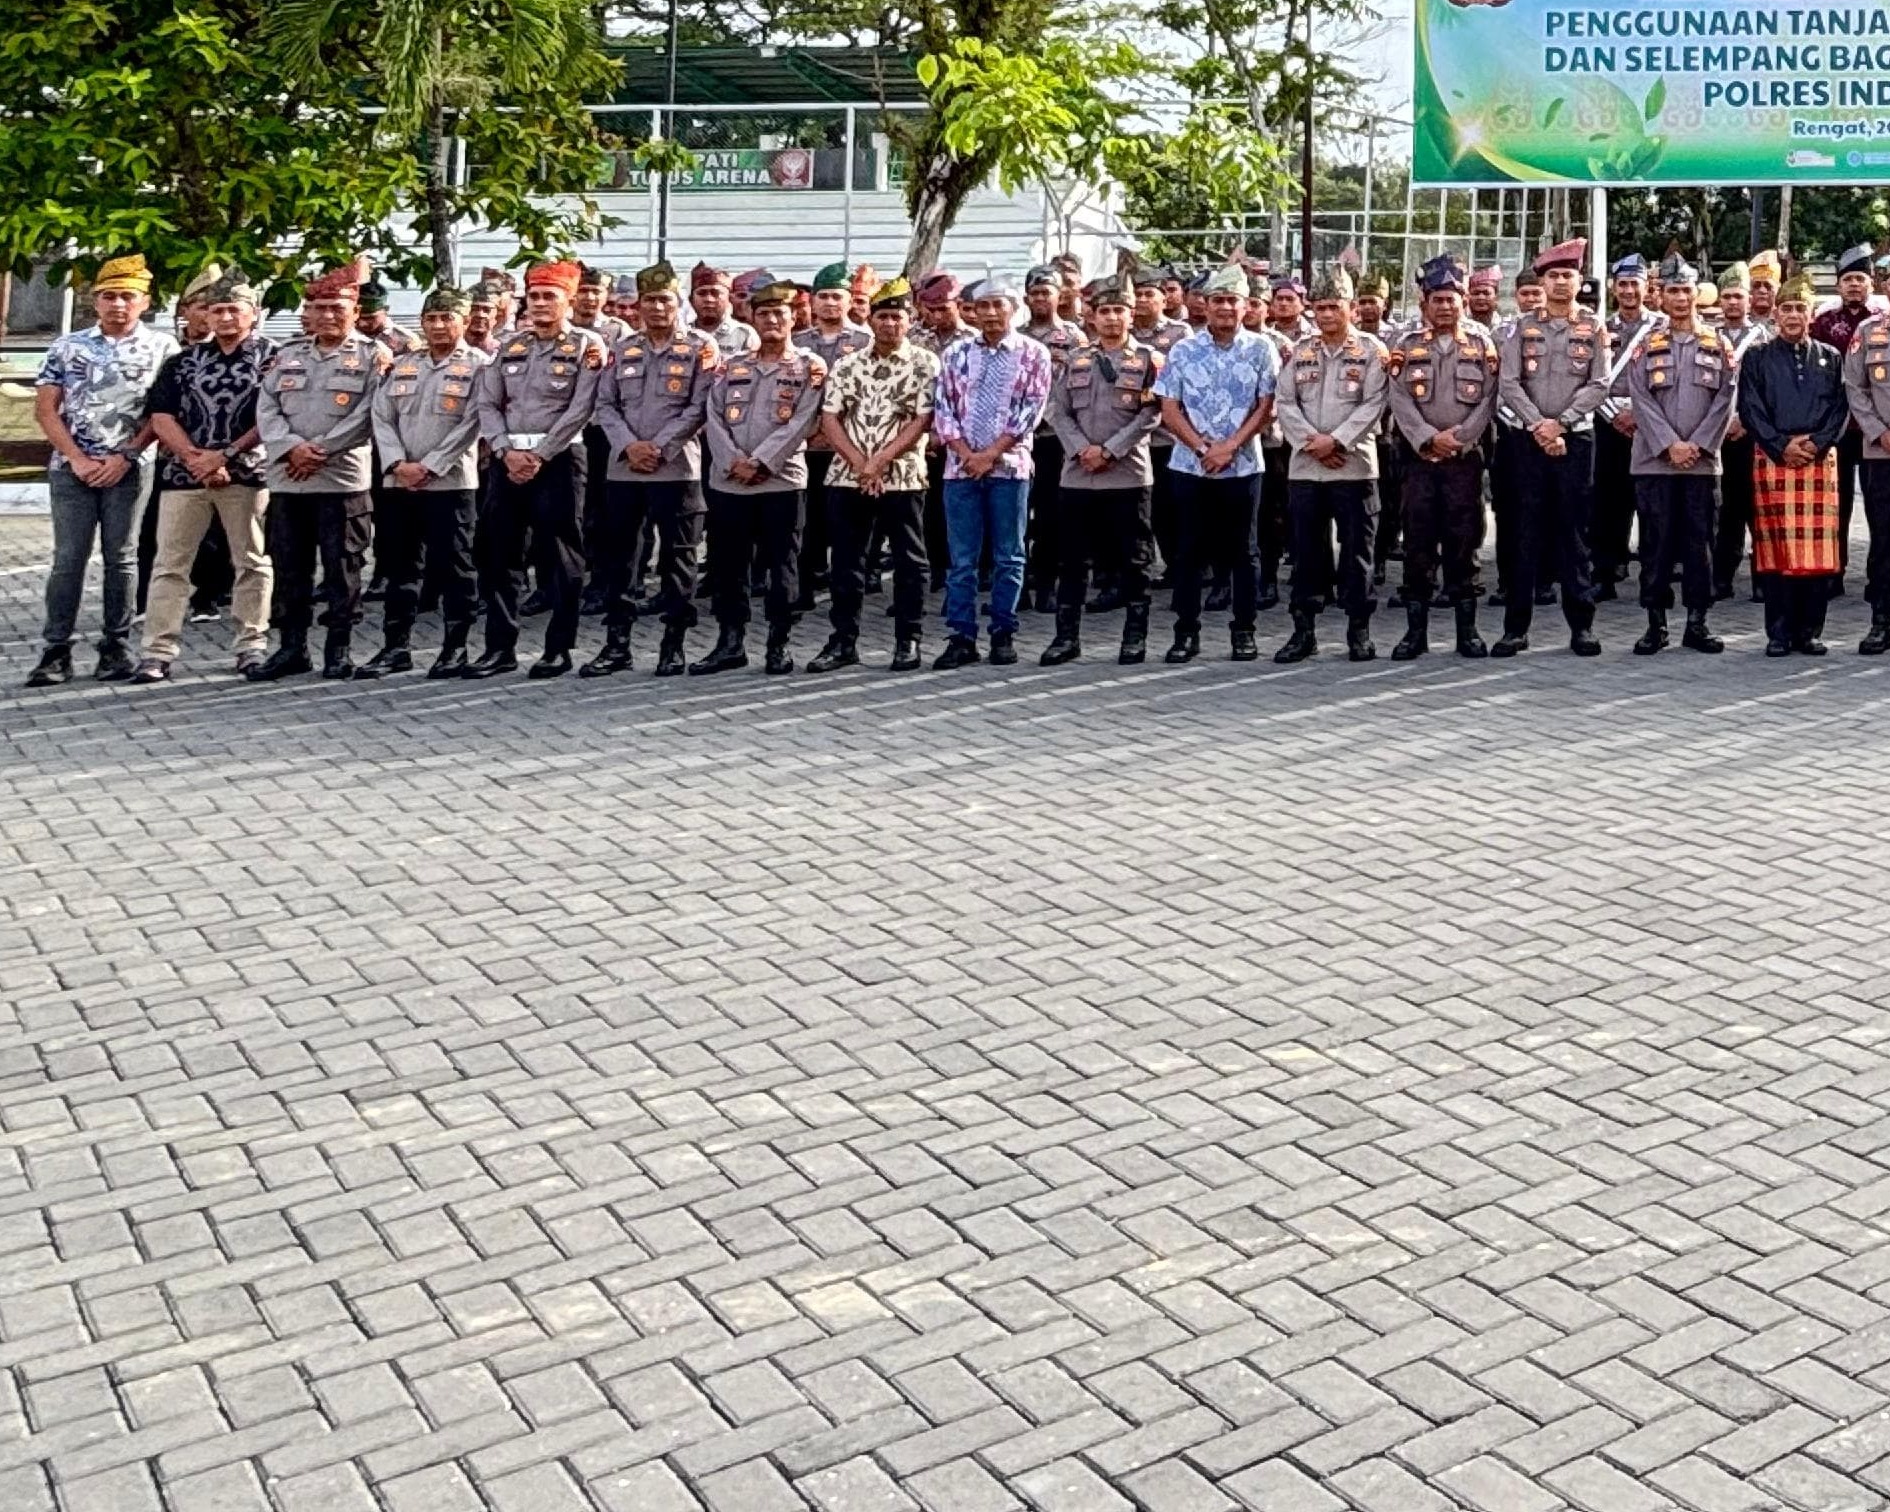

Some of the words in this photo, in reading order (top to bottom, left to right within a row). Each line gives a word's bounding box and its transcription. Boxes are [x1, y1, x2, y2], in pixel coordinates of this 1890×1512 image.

[1546, 10, 1778, 37] PENGGUNAAN
[1545, 46, 1616, 72] DAN
[1625, 45, 1820, 71] SELEMPANG
[1704, 81, 1830, 107] POLRES
[1794, 120, 1872, 138] Rengat,
[678, 153, 737, 168] PATI
[629, 169, 694, 186] TUUS
[702, 169, 771, 184] ARENA
